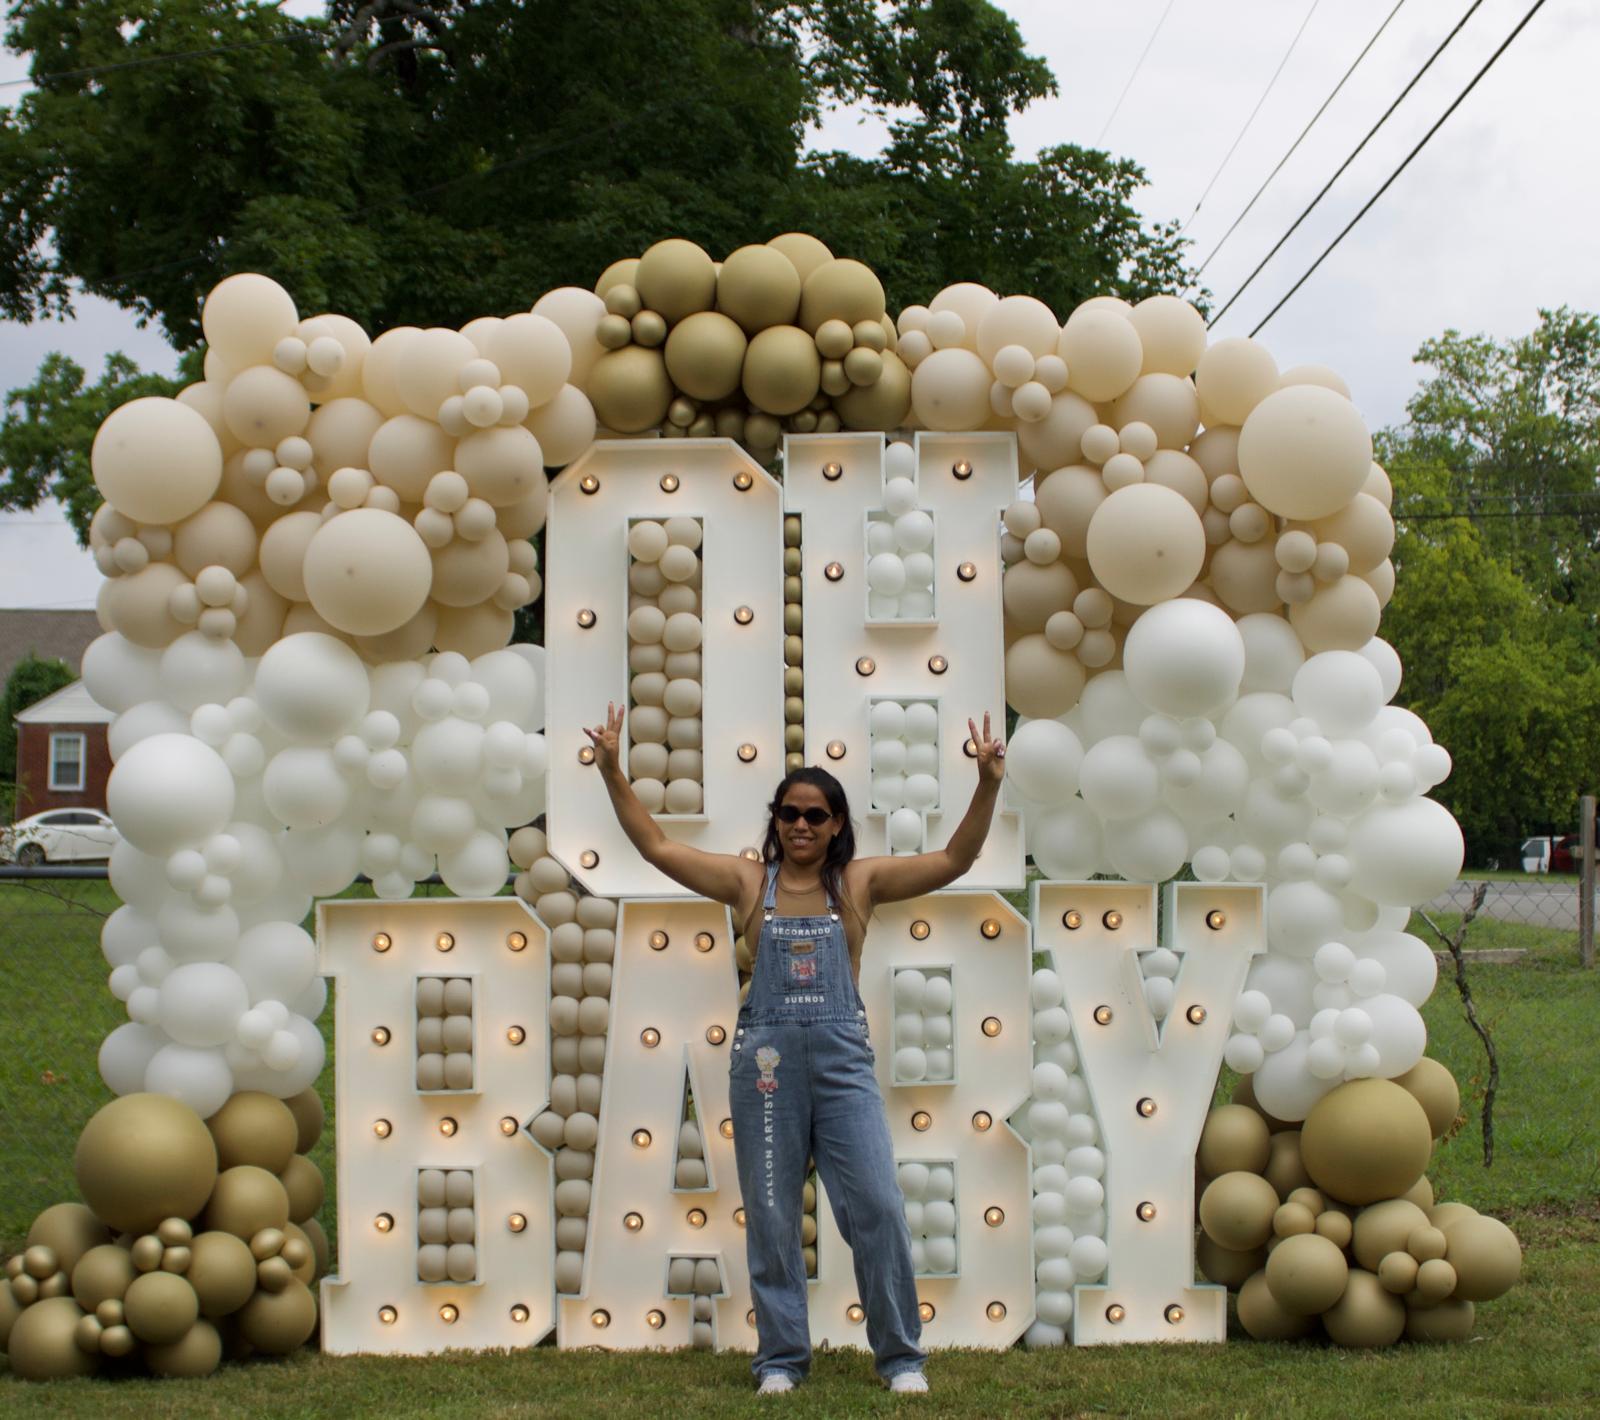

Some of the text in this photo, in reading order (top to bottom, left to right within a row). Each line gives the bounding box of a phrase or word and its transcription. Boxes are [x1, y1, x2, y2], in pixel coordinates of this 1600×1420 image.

[546, 431, 1025, 897] OH
[772, 927, 831, 936] DECORANDO
[315, 880, 1267, 1356] BABY
[765, 1150, 774, 1207] BALLON
